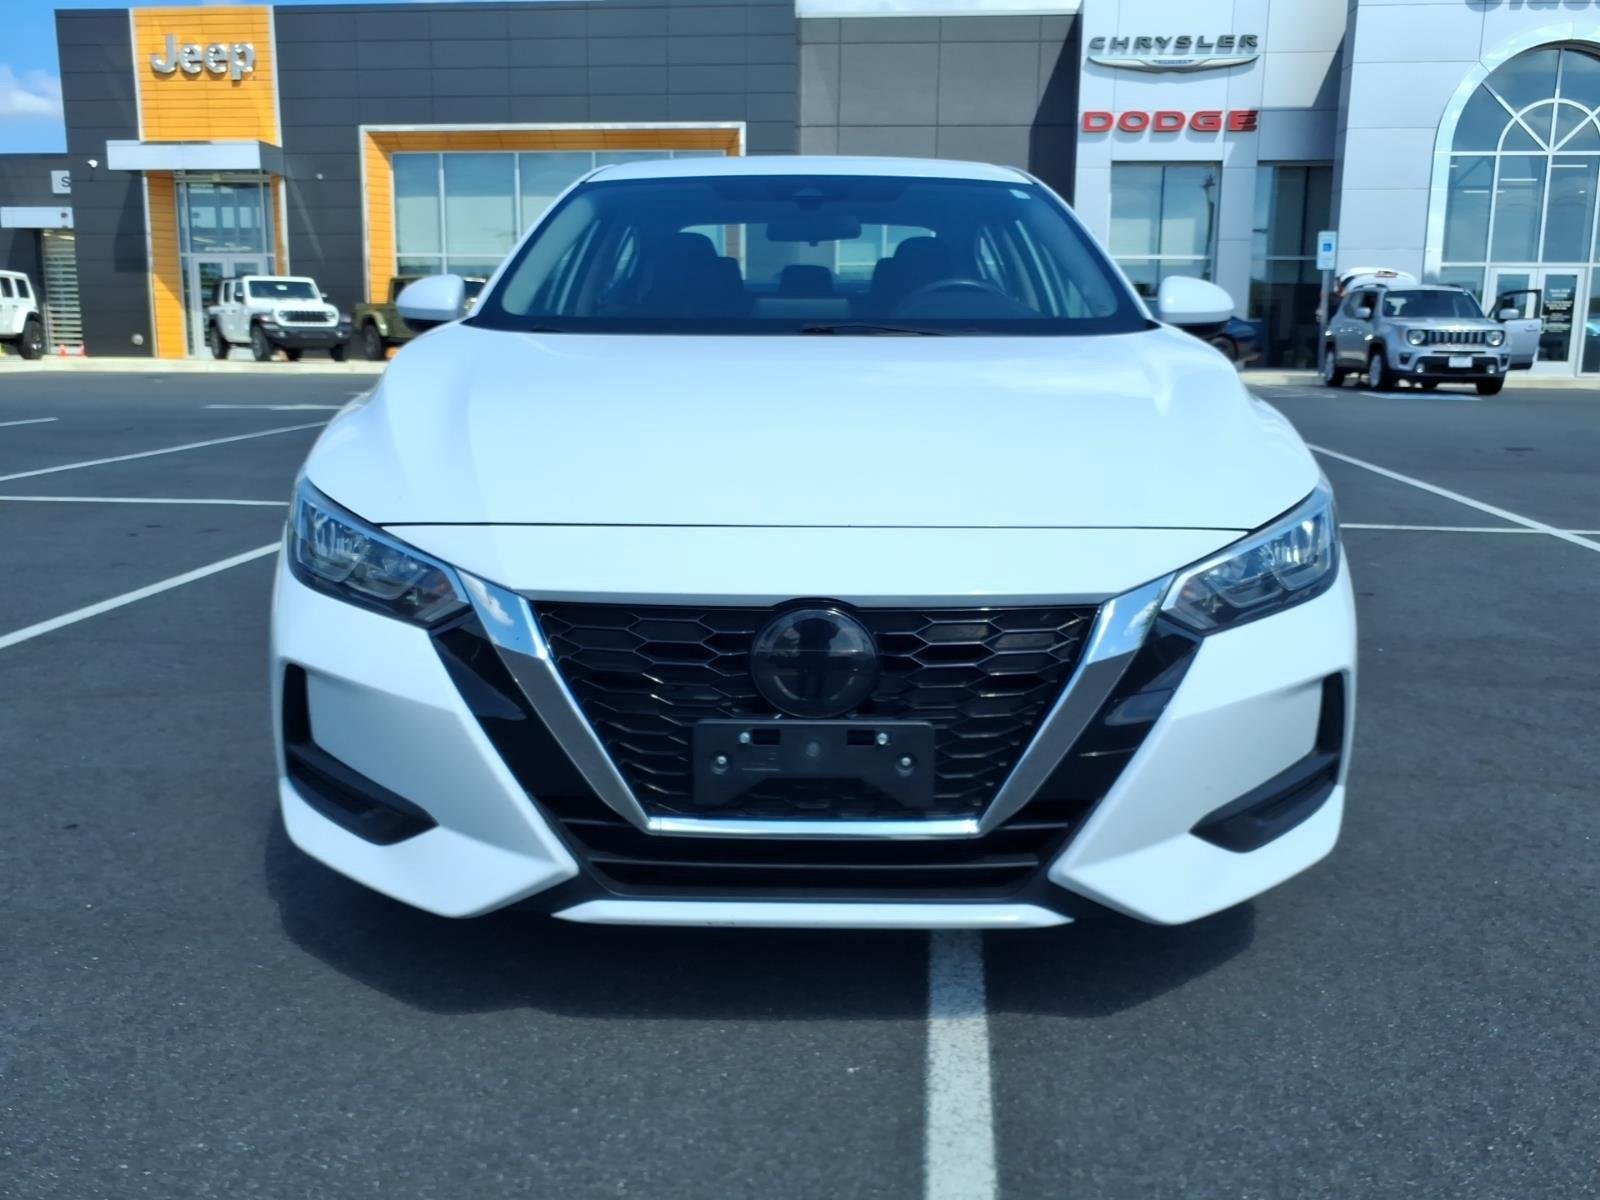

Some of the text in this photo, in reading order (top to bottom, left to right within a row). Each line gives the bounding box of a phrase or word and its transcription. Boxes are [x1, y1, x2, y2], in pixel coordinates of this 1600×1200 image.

[1088, 34, 1258, 51] CHRYSLER
[150, 33, 255, 80] Jeep
[1081, 110, 1259, 133] DODGE
